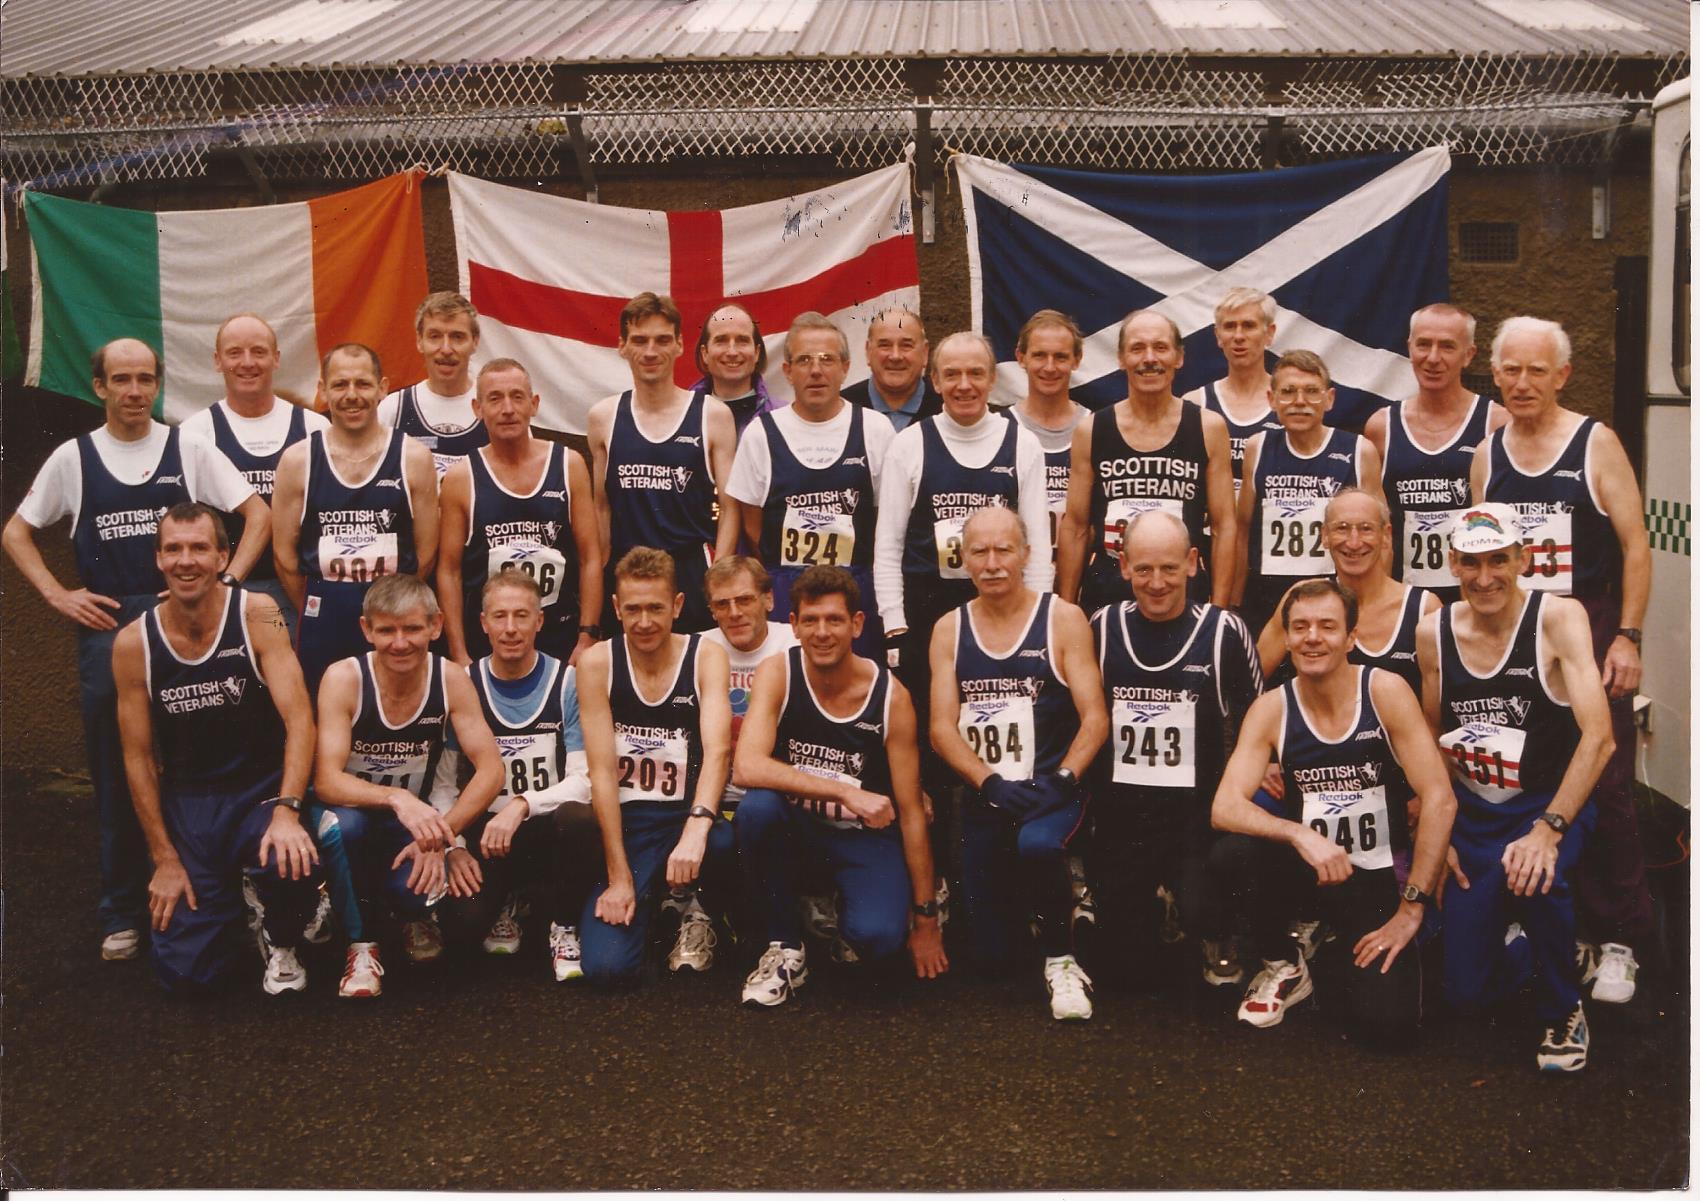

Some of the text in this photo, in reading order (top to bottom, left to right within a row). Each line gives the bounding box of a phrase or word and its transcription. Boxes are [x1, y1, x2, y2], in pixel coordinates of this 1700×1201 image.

[618, 465, 671, 477] SCOTTISH
[1100, 457, 1198, 480] SCOTTISH
[619, 477, 672, 490] VETERANS
[1265, 475, 1318, 488] SCOTTISH
[1396, 478, 1449, 492] SCOTTISH
[1103, 478, 1196, 500] VETERANS
[1265, 488, 1319, 499] VETERANS
[785, 491, 839, 507] SCOTTISH
[932, 493, 986, 506] SCOTTISH
[1122, 500, 1162, 508] Reebok
[1274, 499, 1316, 507] Reebok
[1399, 491, 1452, 504] VETERANS
[96, 508, 154, 528] SCOTTISH
[318, 510, 374, 523] SCOTTISH
[798, 509, 837, 522] Reebok
[1414, 511, 1450, 521] Reebok
[99, 522, 158, 541] VETERANS
[321, 523, 377, 537] VETERANS
[485, 521, 540, 537] SCOTTISH
[334, 535, 377, 544] Reebok
[1270, 520, 1326, 557] 282
[785, 528, 839, 566] 324
[1410, 533, 1453, 570] 28
[161, 681, 219, 702] SCOTTISH
[961, 678, 1018, 692] SCOTTISH
[1112, 686, 1172, 701] SCOTTISH
[164, 694, 224, 714] VETERANS
[969, 700, 1010, 710] Reebok
[1126, 702, 1171, 711] Reebok
[614, 722, 671, 740] SCOTTISH
[354, 740, 415, 753] SCOTTISH
[496, 736, 536, 745] Reebok
[625, 734, 666, 747] Reebok
[966, 722, 1023, 764] 284
[1120, 725, 1181, 767] 243
[788, 738, 846, 762] SCOTTISH
[363, 756, 408, 765] Reebok
[789, 750, 846, 773] VETERANS
[498, 756, 550, 796] 85
[618, 755, 678, 796] 203
[1294, 765, 1357, 782] SCOTTISH
[1297, 778, 1362, 793] VETERANS
[1319, 792, 1364, 801] Reebok
